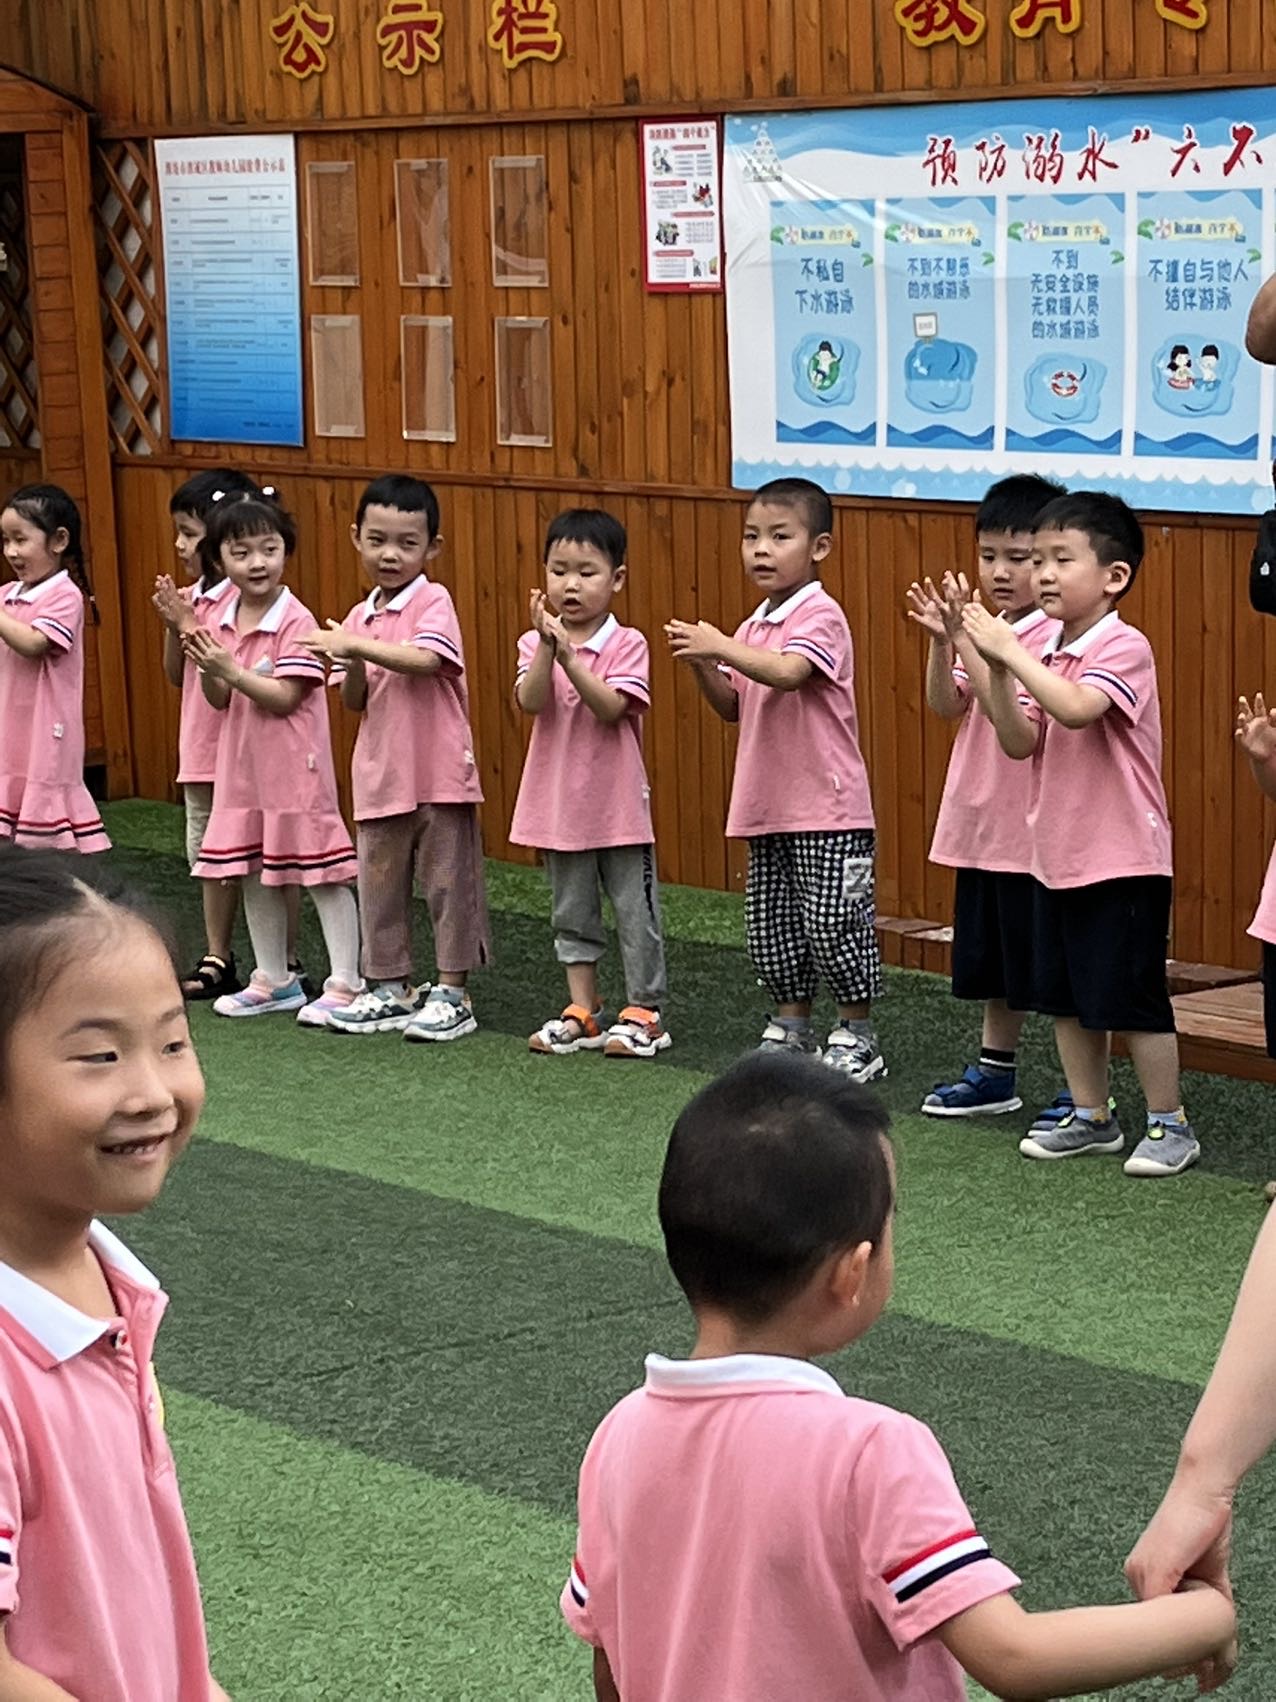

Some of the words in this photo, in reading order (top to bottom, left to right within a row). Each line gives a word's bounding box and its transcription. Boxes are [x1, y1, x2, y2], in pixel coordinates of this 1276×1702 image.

[270, 0, 563, 79] 公示栏
[801, 257, 844, 283] 不私自
[1051, 249, 1079, 270] 不到
[1148, 258, 1249, 284] 不擅自与他人
[1030, 273, 1100, 294] 无安全设施
[795, 288, 854, 315] 下水游泳
[1164, 286, 1232, 312] 结伴游泳
